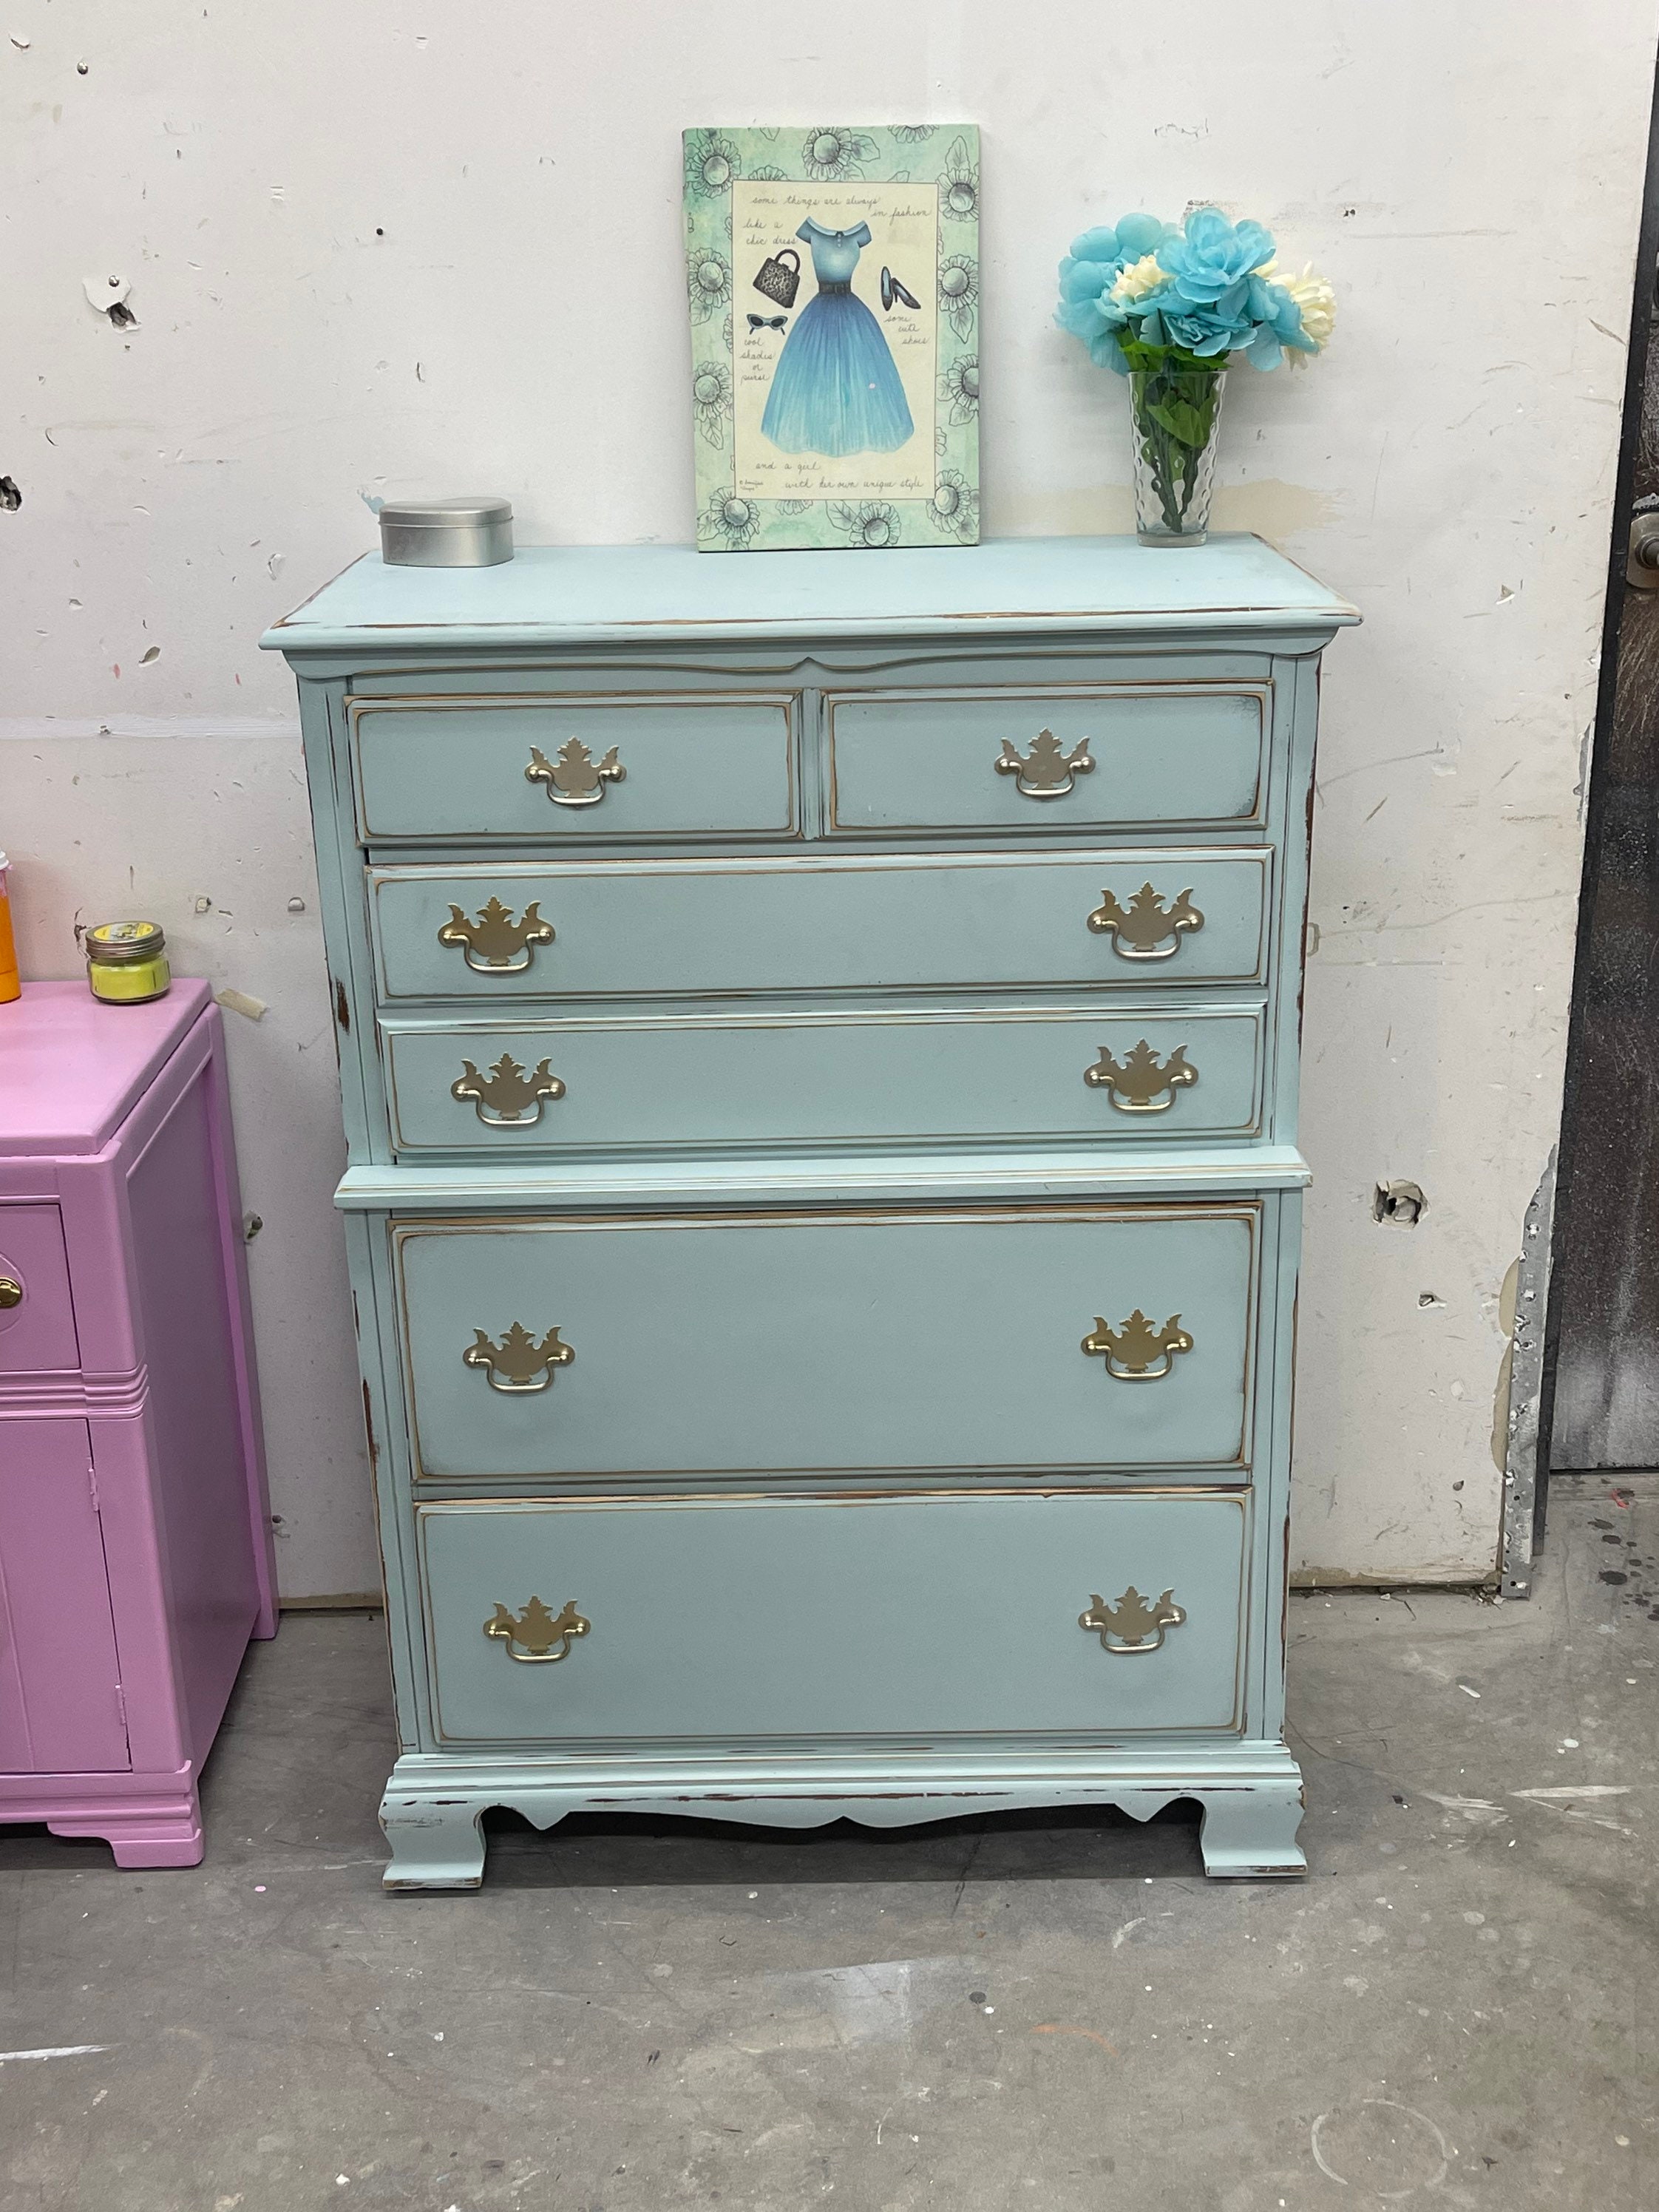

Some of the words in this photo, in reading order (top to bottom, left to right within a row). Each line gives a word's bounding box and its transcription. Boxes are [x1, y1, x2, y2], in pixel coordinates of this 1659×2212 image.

[784, 195, 819, 209] things
[846, 195, 881, 211] always
[889, 205, 932, 226] fashion
[742, 217, 767, 228] like
[746, 234, 768, 245] chic
[773, 235, 798, 245] dress
[744, 336, 764, 346] cool
[901, 335, 930, 345] shoes
[739, 349, 776, 360] shades
[740, 374, 771, 386] purse
[755, 461, 776, 469] and
[797, 461, 821, 475] girl
[784, 477, 813, 488] with
[818, 476, 835, 488] her
[863, 481, 897, 493] unique
[900, 475, 924, 491] style
